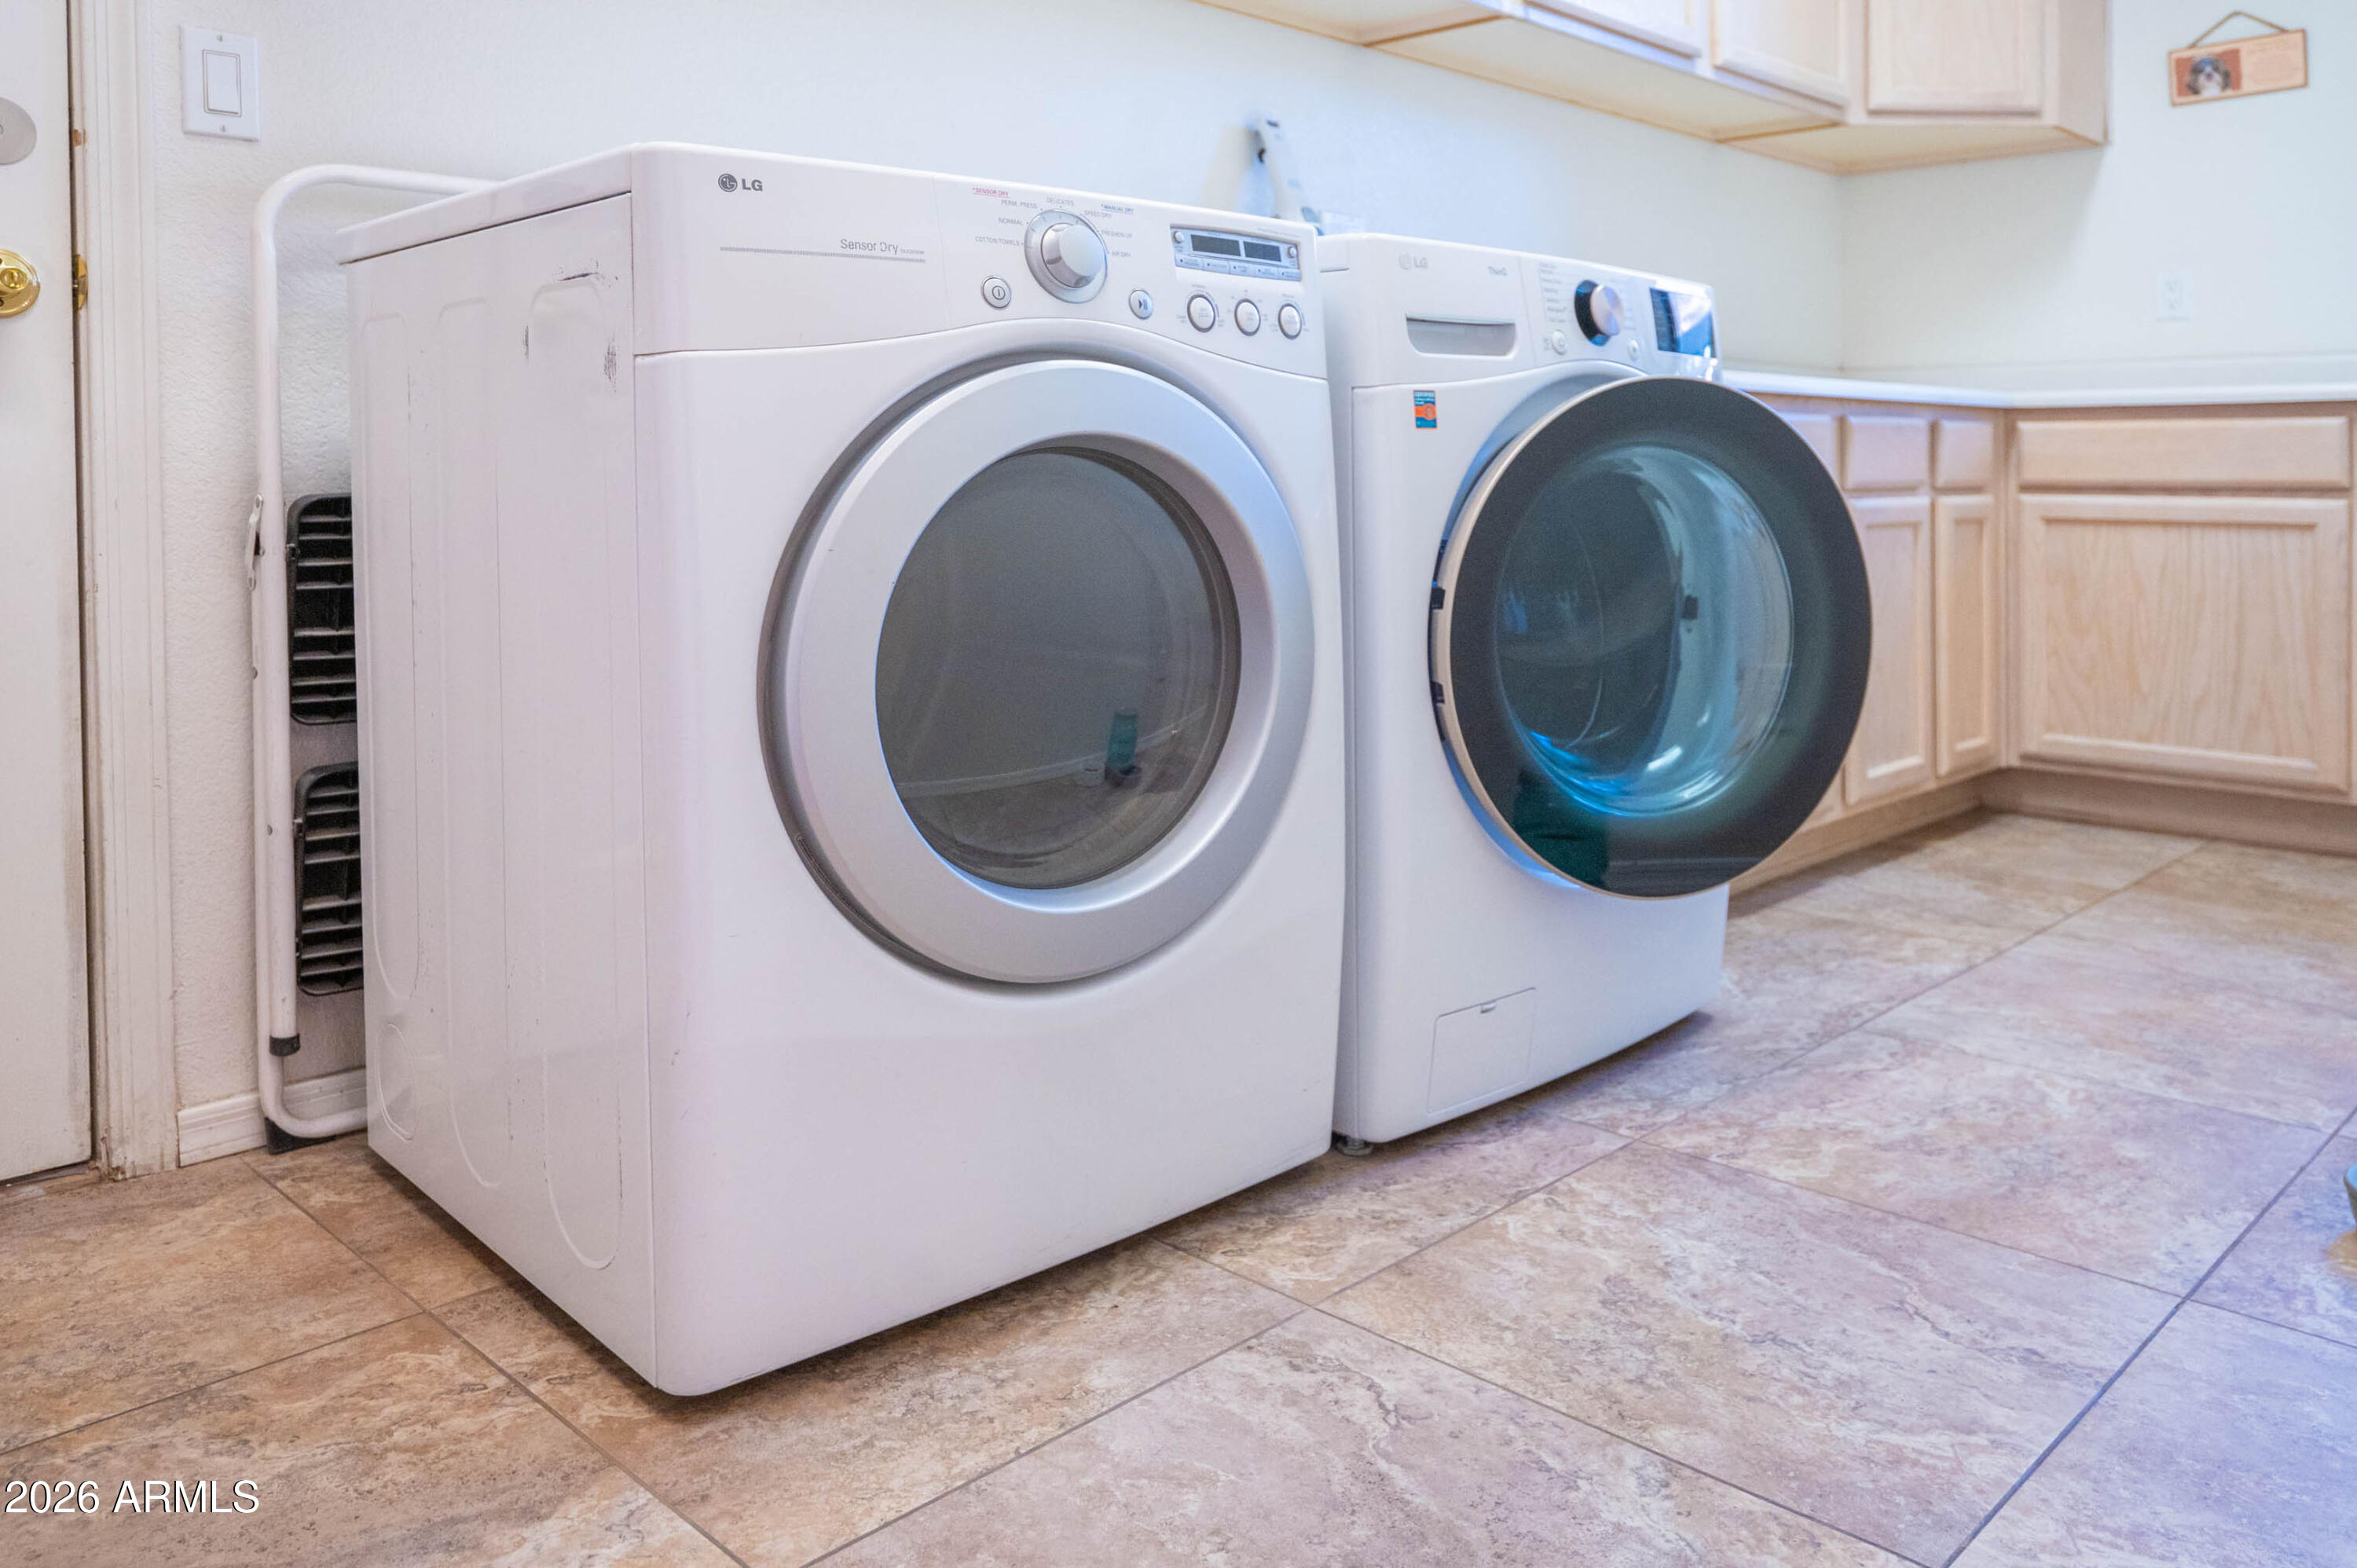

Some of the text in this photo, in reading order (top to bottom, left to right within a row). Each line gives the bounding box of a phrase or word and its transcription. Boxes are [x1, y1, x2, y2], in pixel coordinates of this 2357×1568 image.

[742, 178, 764, 192] LG
[1047, 197, 1074, 206] DELICATES
[840, 238, 877, 252] Sensor
[879, 241, 899, 255] Dry
[1413, 256, 1428, 268] LG
